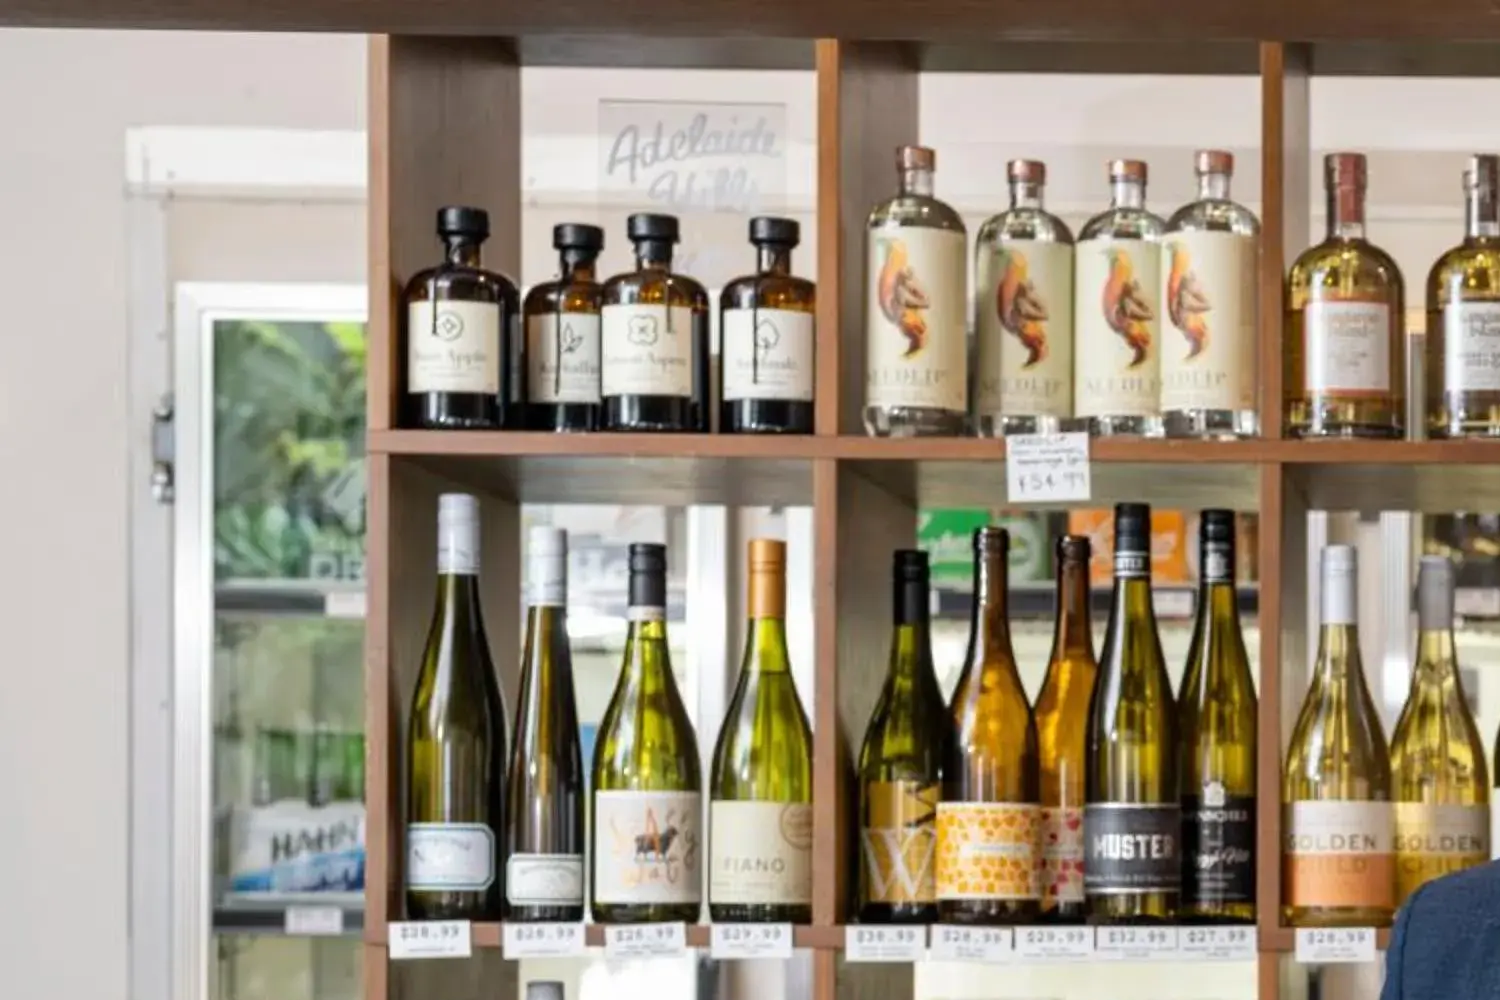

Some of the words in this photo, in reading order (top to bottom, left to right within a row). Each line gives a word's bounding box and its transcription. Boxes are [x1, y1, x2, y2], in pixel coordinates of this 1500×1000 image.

[607, 112, 783, 185] Adelaide
[1093, 834, 1175, 861] MUSTER
[1287, 833, 1377, 851] GOLDEN
[1393, 835, 1482, 852] GOLDEN
[724, 857, 786, 876] FIANO
